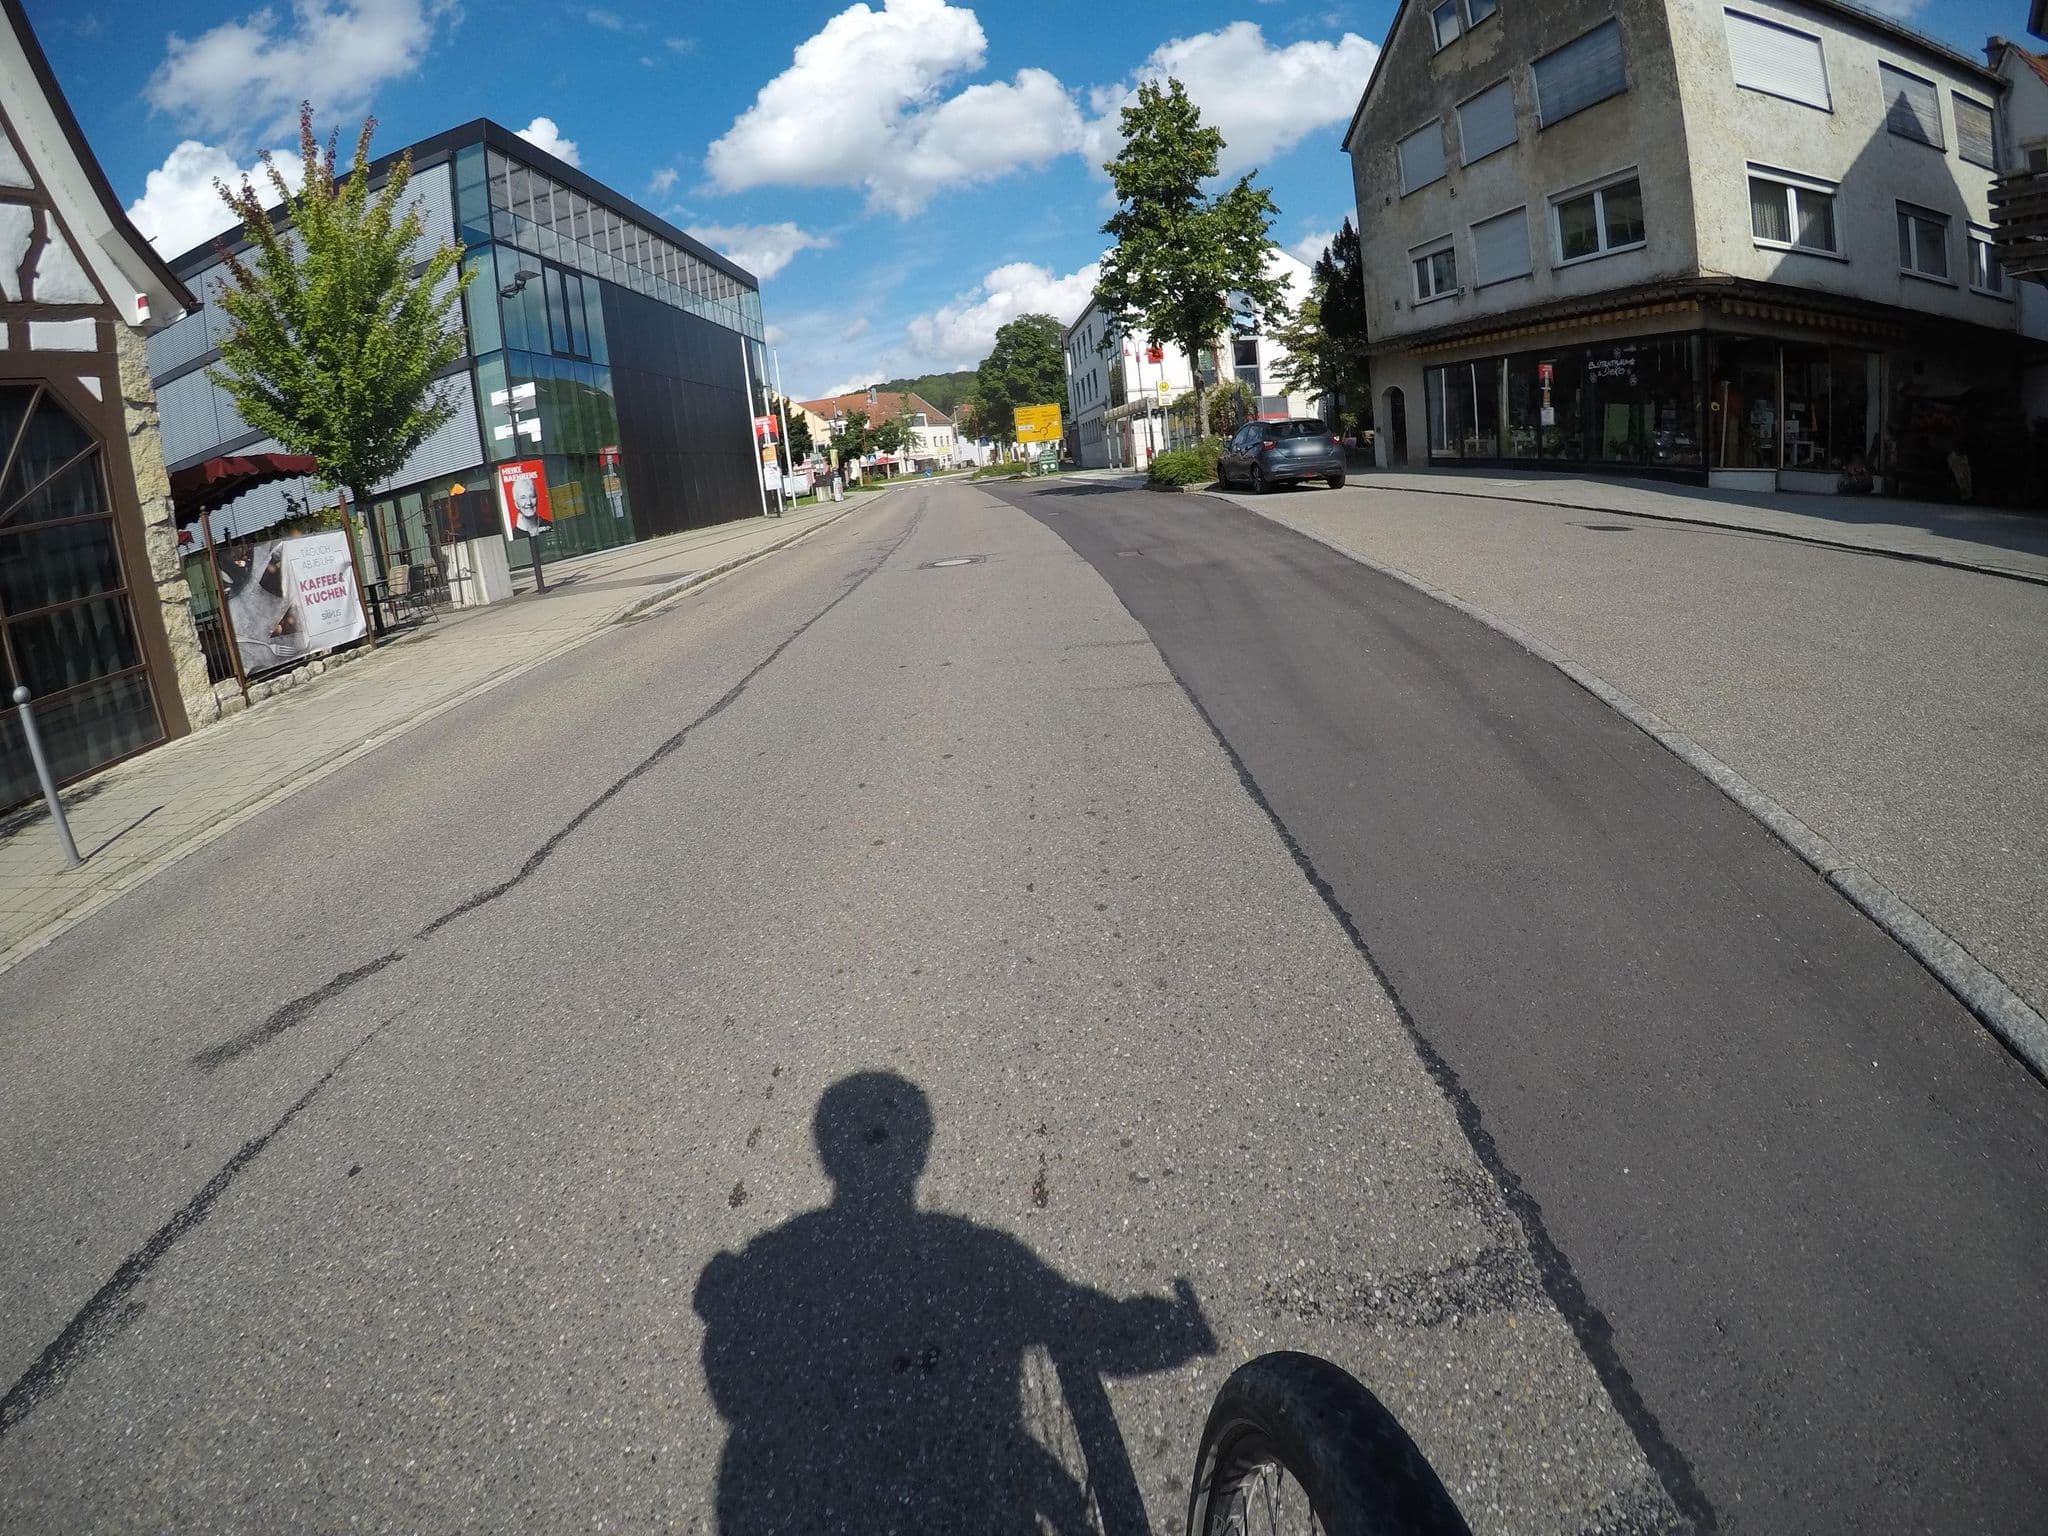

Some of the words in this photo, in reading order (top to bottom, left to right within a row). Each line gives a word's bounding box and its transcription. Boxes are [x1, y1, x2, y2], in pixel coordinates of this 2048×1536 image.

[501, 466, 522, 475] HEIKE
[299, 573, 337, 592] KAFFEE
[305, 586, 347, 606] KUCHEN
